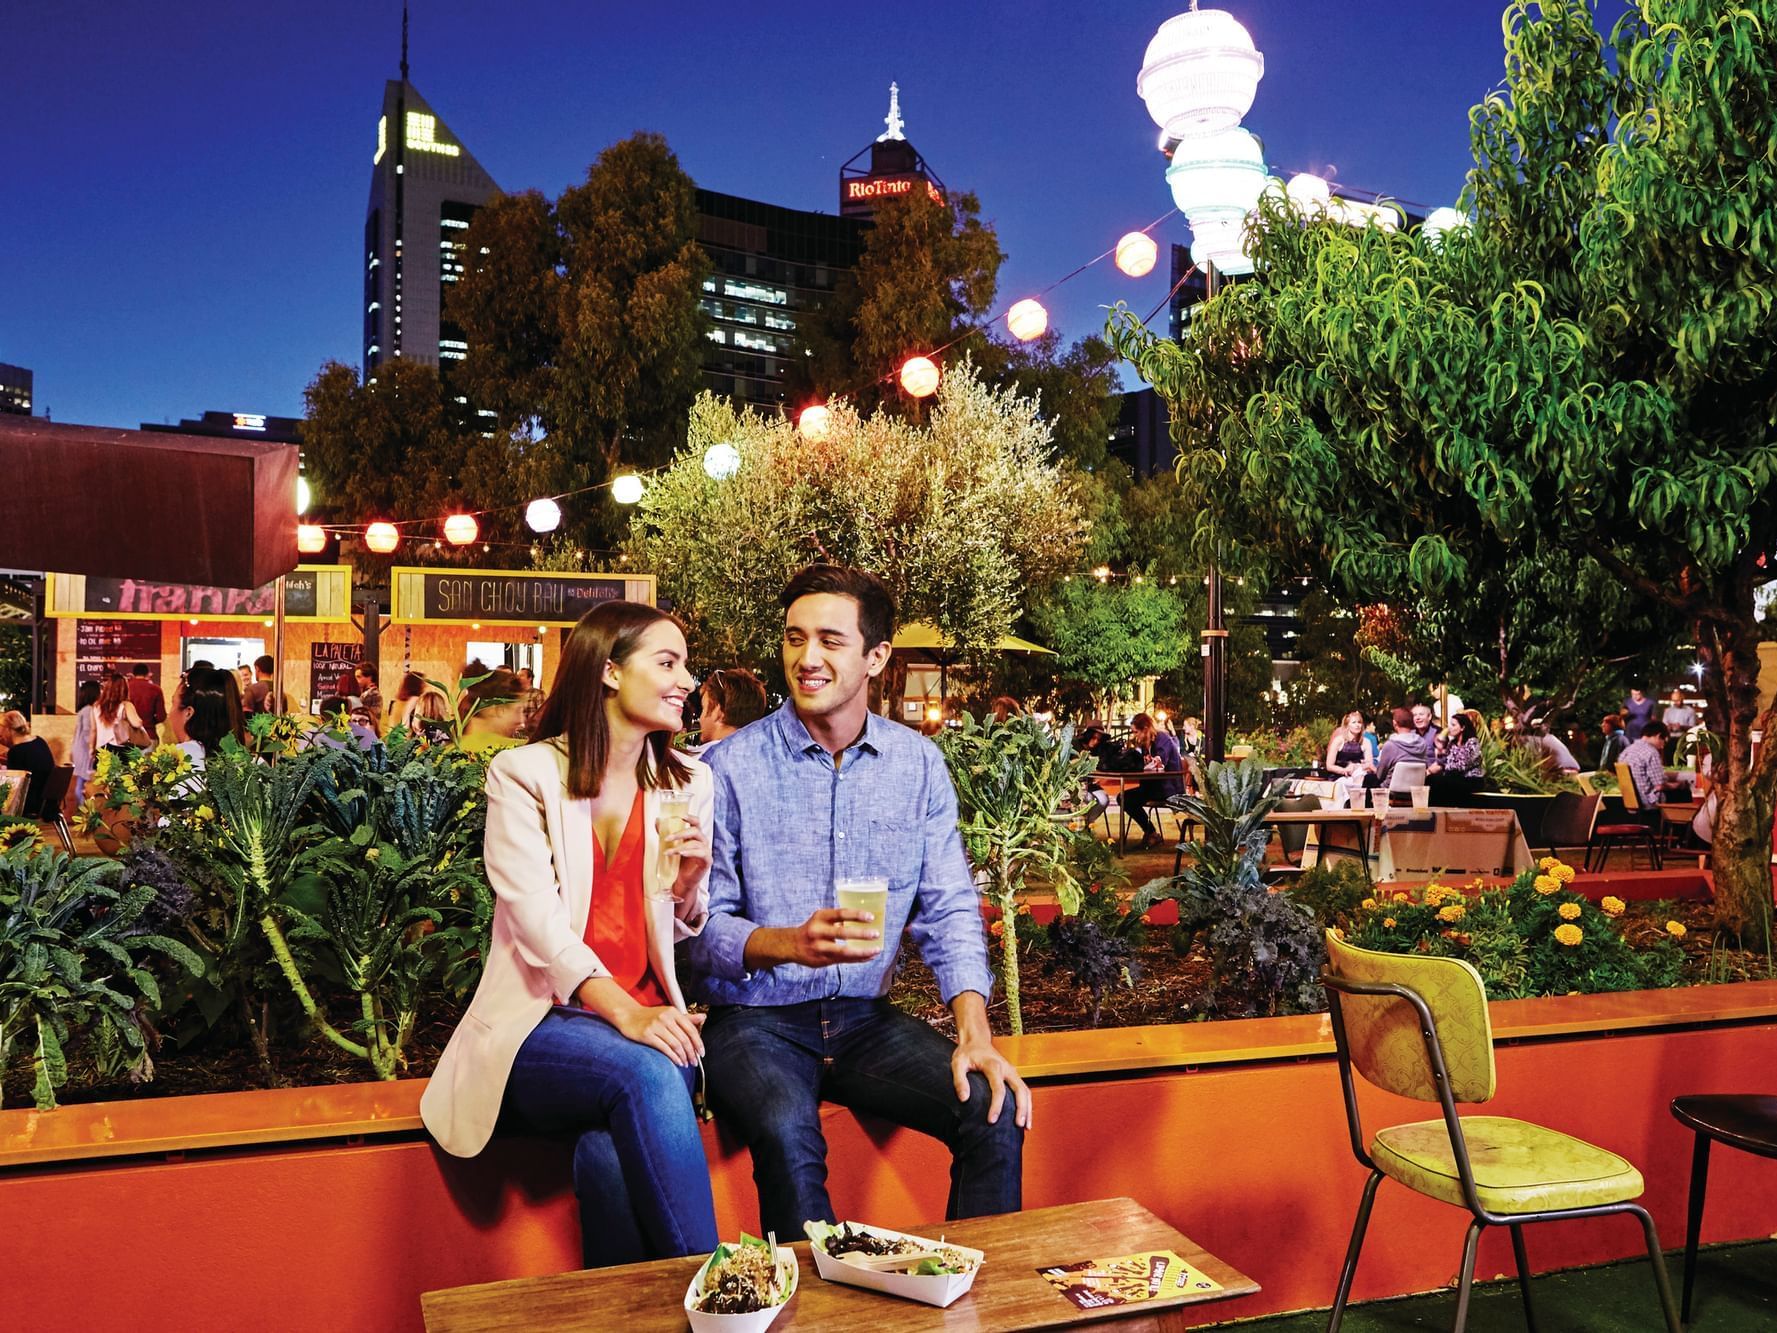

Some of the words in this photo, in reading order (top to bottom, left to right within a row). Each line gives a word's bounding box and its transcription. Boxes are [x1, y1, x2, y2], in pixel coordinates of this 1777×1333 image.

[438, 579, 473, 612] SAN
[480, 581, 527, 613] CHOY
[532, 582, 564, 614] BAU
[315, 643, 328, 657] LA
